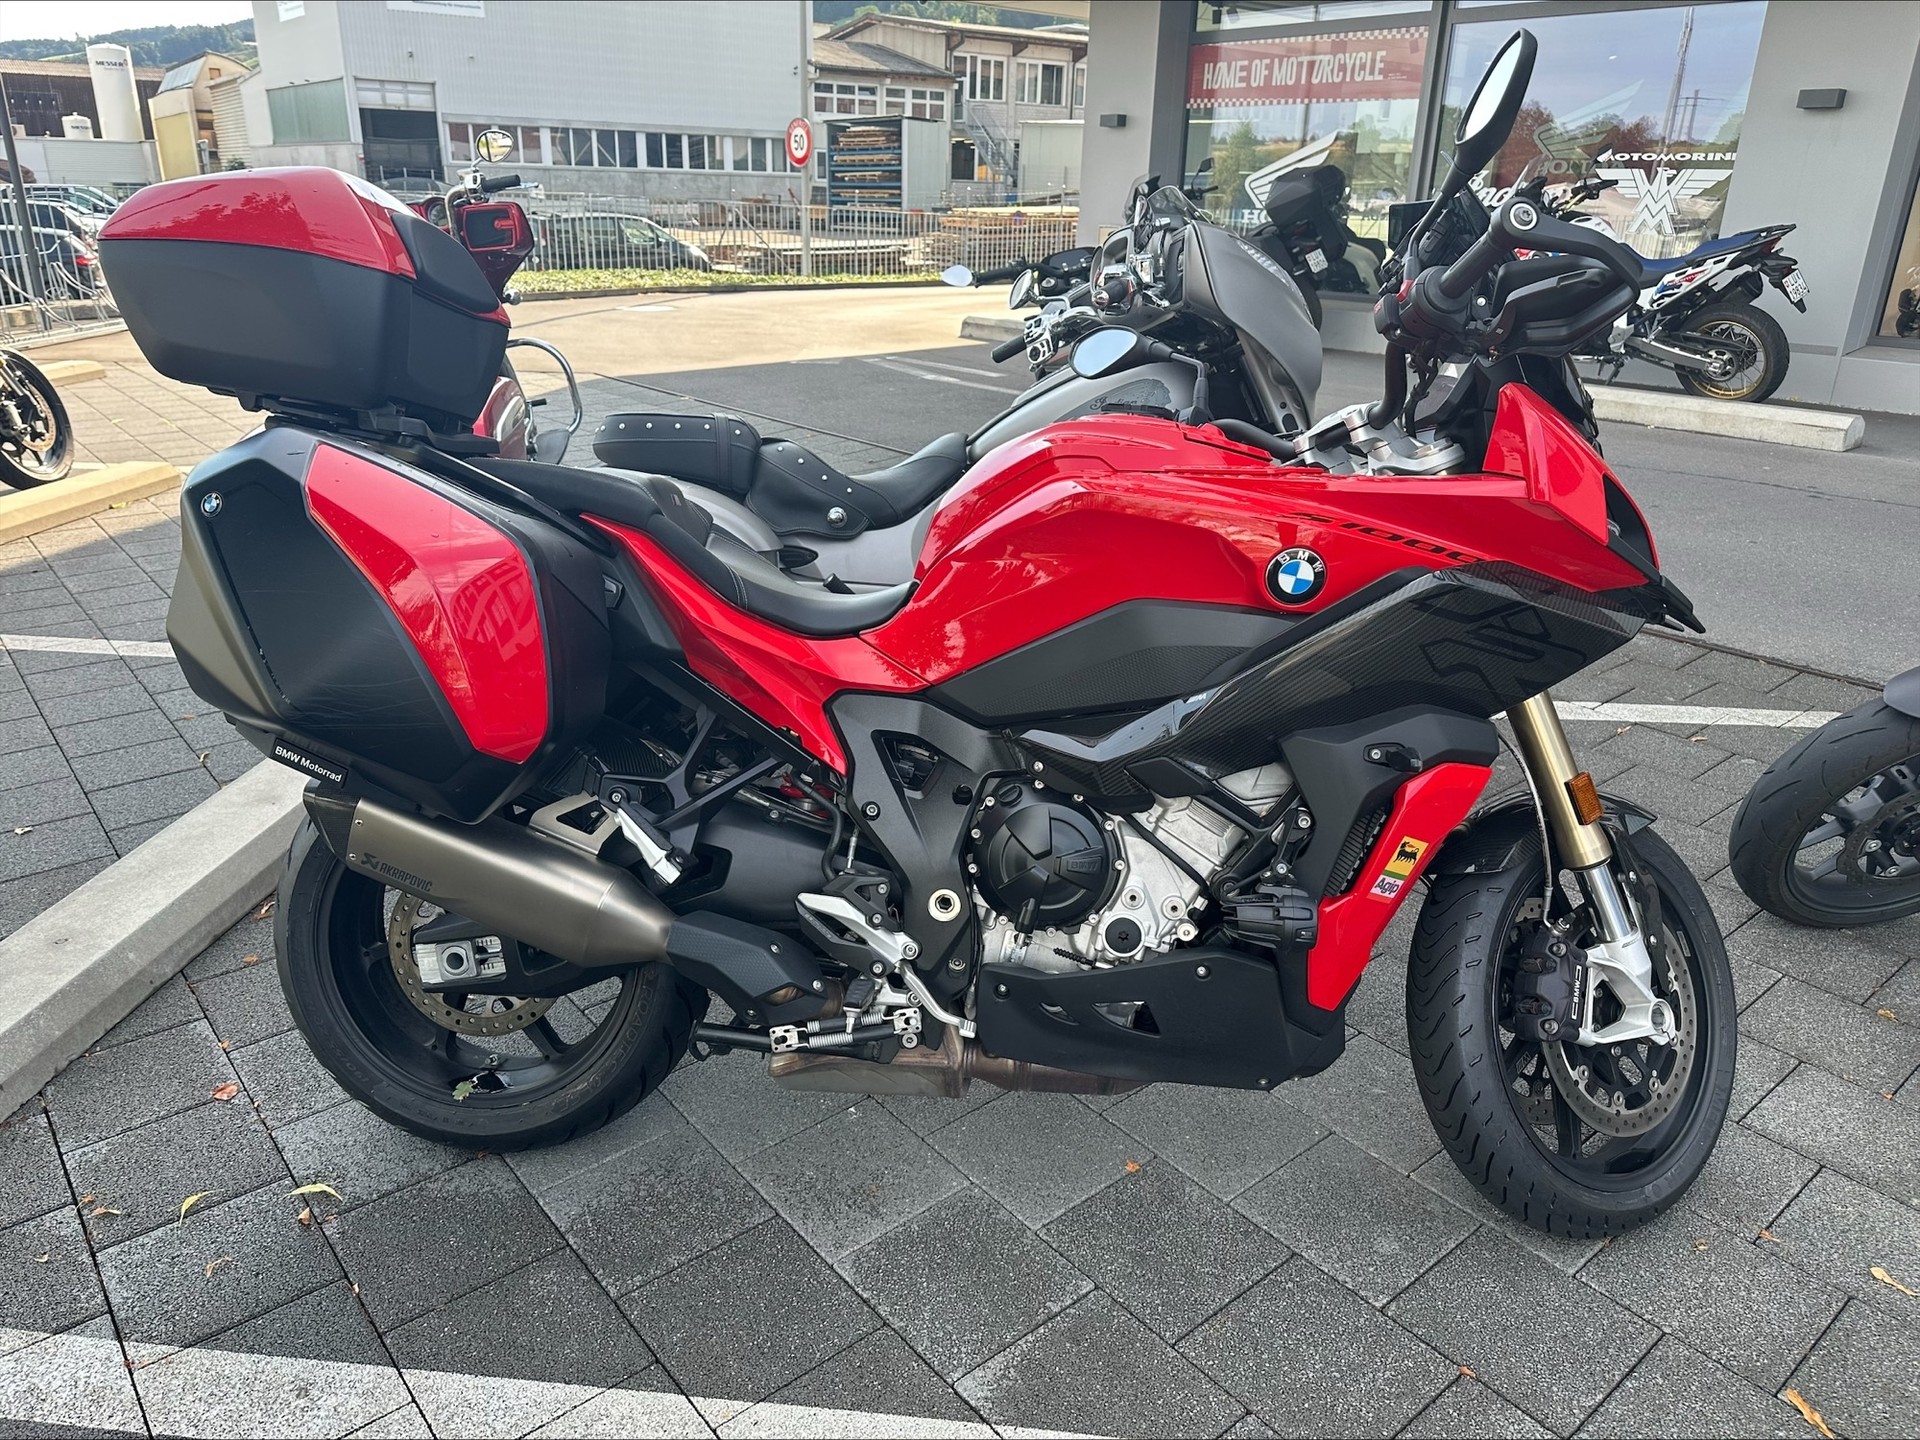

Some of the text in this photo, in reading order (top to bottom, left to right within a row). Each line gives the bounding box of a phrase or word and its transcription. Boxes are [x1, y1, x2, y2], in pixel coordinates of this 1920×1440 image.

[1250, 59, 1271, 87] OF
[793, 134, 805, 151] 50
[1277, 550, 1325, 574] BMW
[275, 745, 342, 782] BMW Motorrad
[1071, 860, 1099, 870] BMW
[1374, 877, 1400, 895] Agip
[1573, 979, 1581, 1003] BMW
